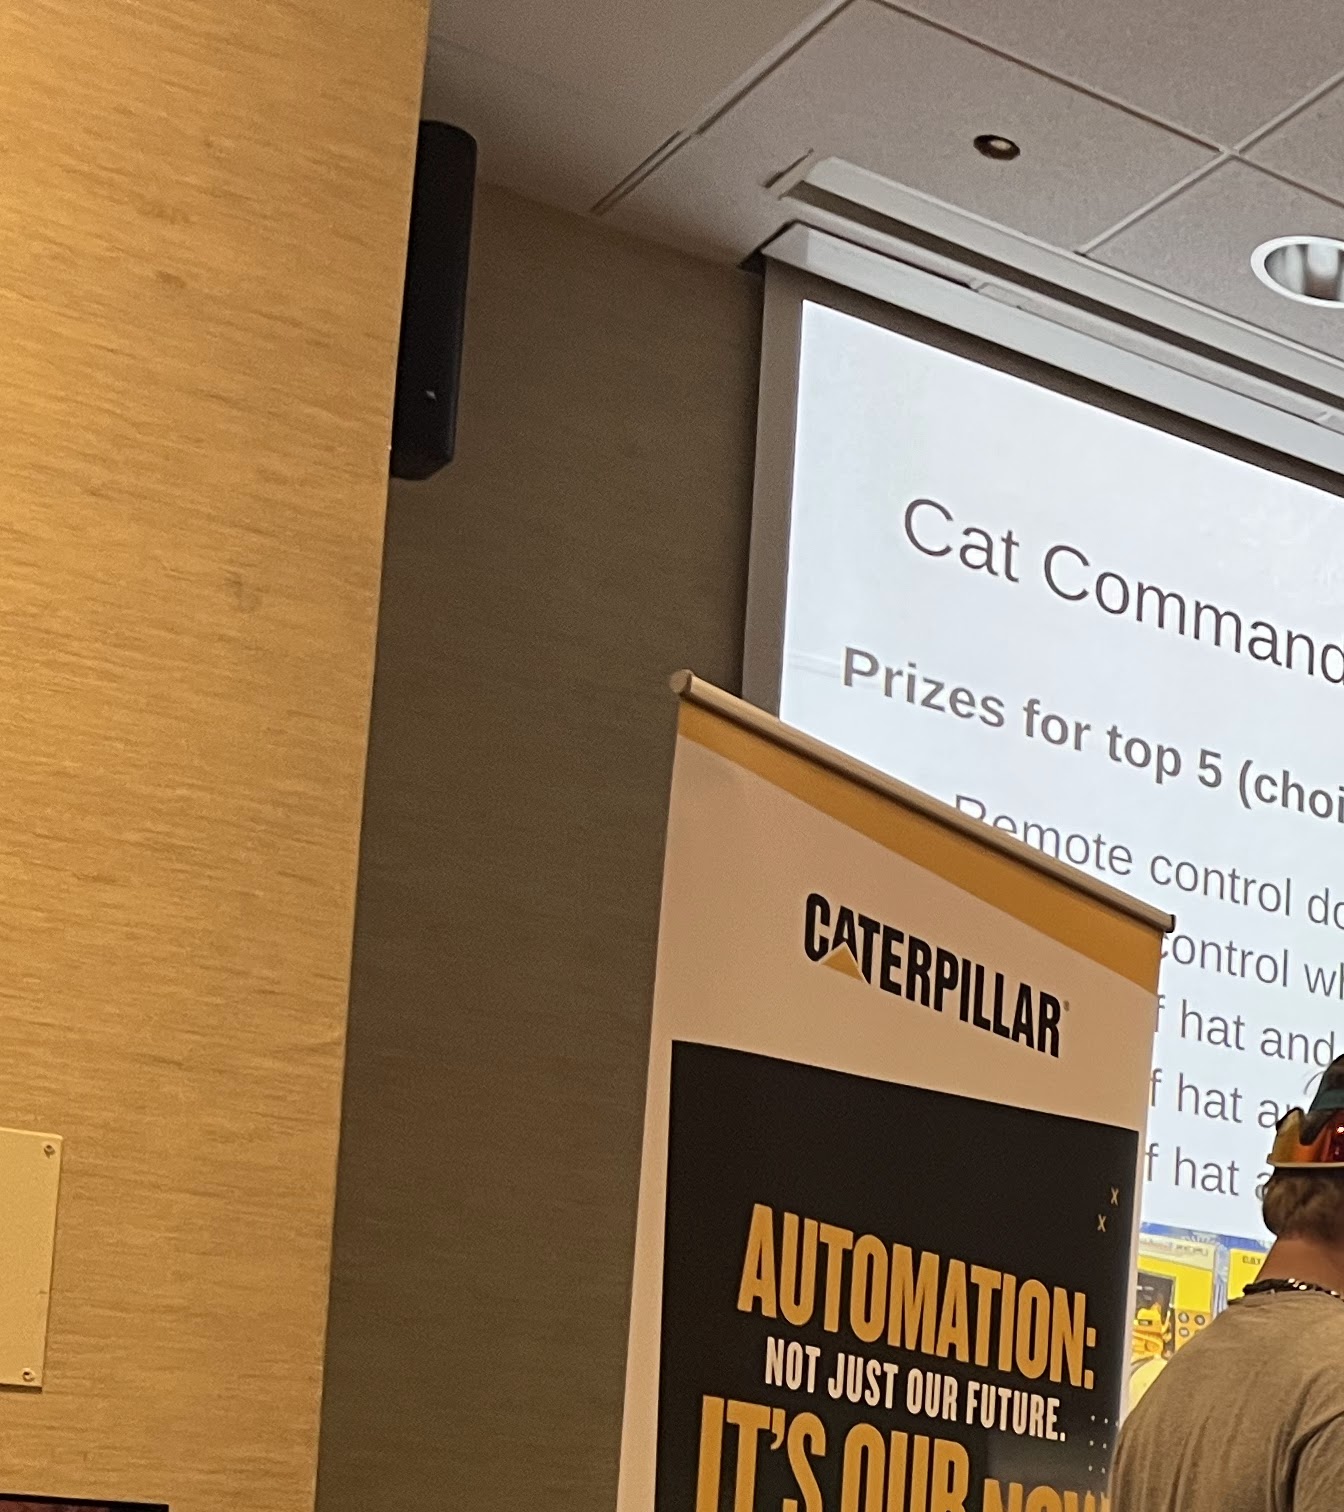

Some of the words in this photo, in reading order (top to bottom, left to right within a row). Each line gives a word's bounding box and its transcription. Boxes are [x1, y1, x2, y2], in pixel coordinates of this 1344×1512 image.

[904, 498, 1019, 583] Cat
[843, 646, 1005, 728] Prizes
[1023, 698, 1092, 752] for
[1106, 724, 1182, 785] top
[1198, 748, 1222, 788] 5
[1150, 853, 1292, 917] control
[804, 892, 1062, 1059] CATERPILLAR
[1180, 998, 1246, 1052] hat
[1260, 1031, 1335, 1068] and
[1177, 1073, 1243, 1126] hat
[1173, 1147, 1240, 1197] hat
[736, 1203, 1097, 1391] AUTOMATION:
[764, 1336, 821, 1394] NOT
[828, 1351, 899, 1409] JUST
[906, 1368, 958, 1422] OUR
[965, 1381, 1067, 1443] FUTURE.
